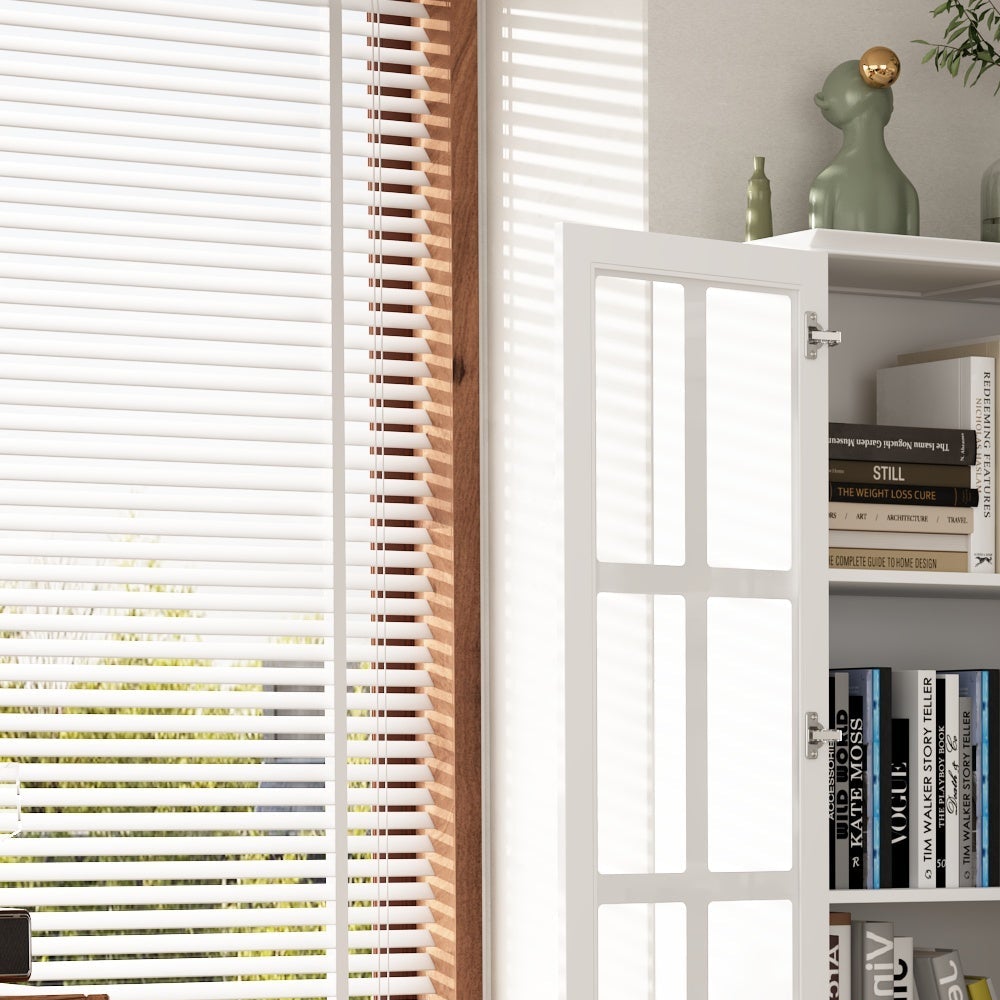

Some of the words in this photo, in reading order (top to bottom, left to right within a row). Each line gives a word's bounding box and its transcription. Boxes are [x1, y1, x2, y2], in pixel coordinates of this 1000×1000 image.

[856, 438, 882, 448] Garden
[884, 439, 912, 450] Noguchi
[913, 442, 936, 451] Isamu
[936, 443, 950, 452] The
[873, 465, 905, 481] STILL
[838, 487, 854, 497] THE
[856, 488, 888, 498] WEIGHT
[891, 490, 912, 500] LOSS
[914, 490, 936, 500] CURE
[887, 514, 928, 522] ARCHITECTURE
[835, 556, 866, 567] COMPLETE
[868, 556, 885, 568] GUIDE
[888, 557, 894, 568] TO
[896, 557, 914, 568] HOME
[915, 558, 936, 569] DESIGN
[924, 677, 932, 725] TELLER
[962, 711, 970, 752] TELLER
[850, 718, 864, 781] MOSS
[924, 728, 932, 772] STORY
[962, 753, 970, 793] STORY
[836, 790, 848, 840] WILD
[850, 787, 864, 848] KATE
[891, 762, 908, 844] VOGUE
[924, 776, 932, 837] WALKER
[962, 795, 970, 840] WALKER
[924, 839, 932, 862] TIM
[962, 843, 970, 865] TIM
